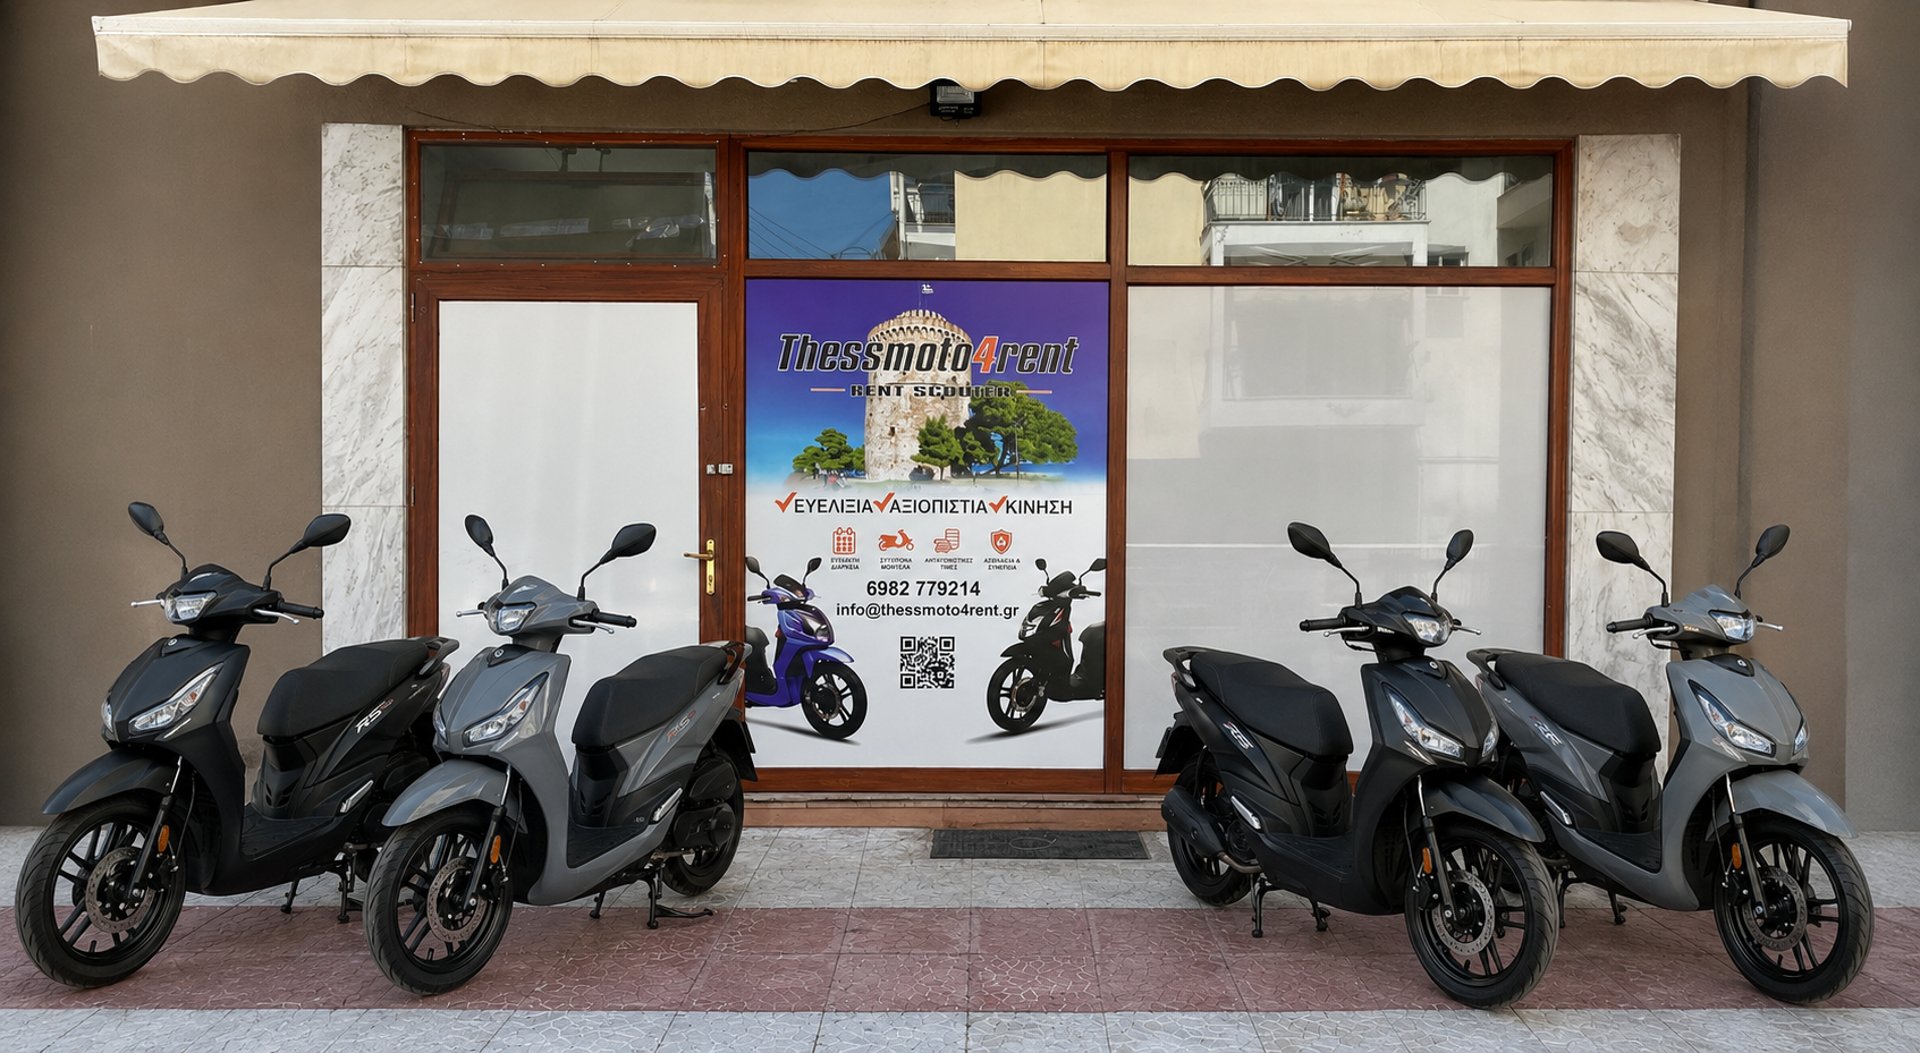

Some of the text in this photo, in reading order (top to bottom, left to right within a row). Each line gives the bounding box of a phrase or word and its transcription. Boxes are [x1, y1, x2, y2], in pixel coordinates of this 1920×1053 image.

[778, 334, 1079, 374] Thessmoto4rent
[851, 385, 903, 397] RENT
[794, 498, 1073, 515] ΕΥΕΛΙΞΙΑ ΑΞΙΟΠΙΣΤΙΑ ΚΙΝΗΣΗ
[866, 580, 981, 597] 6982 779214
[836, 602, 1020, 620] info@thessmoto4rent.gr
